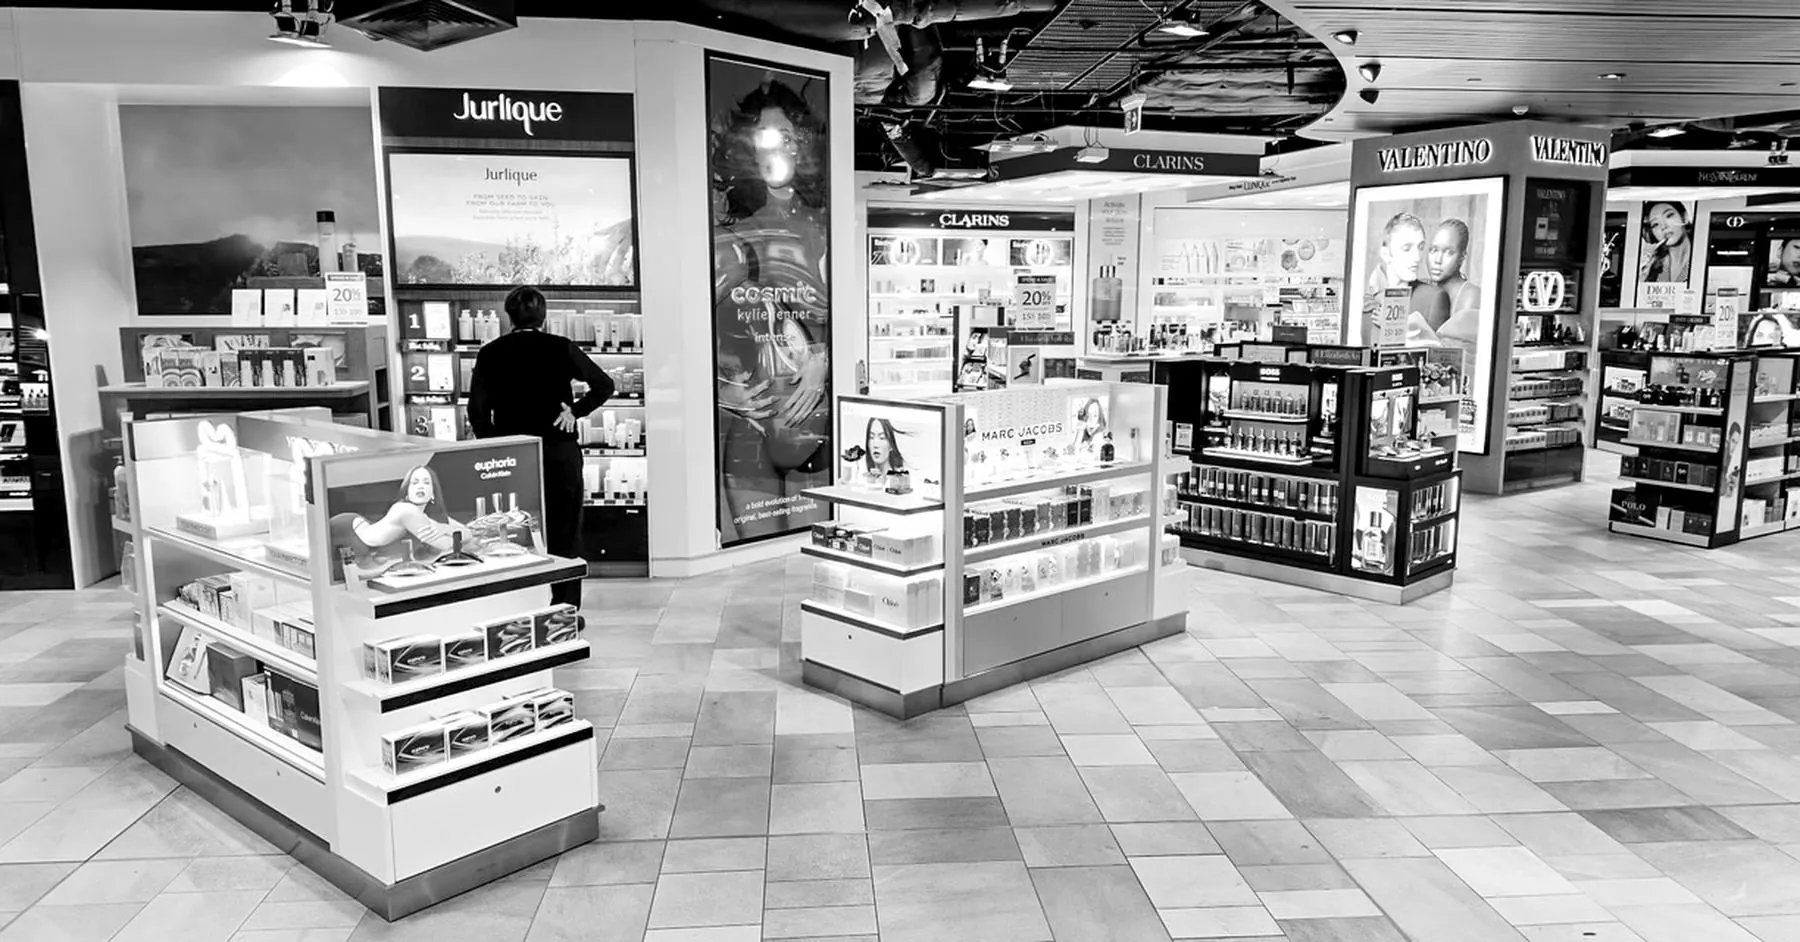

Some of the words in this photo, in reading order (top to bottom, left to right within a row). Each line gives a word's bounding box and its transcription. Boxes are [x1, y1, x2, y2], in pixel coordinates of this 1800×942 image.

[453, 92, 563, 136] Jurlique
[1377, 138, 1492, 172] VALENTINO
[1531, 135, 1608, 167] VALENTINO
[1133, 153, 1205, 171] CLARINS
[485, 167, 538, 187] Jurlique
[939, 213, 1010, 228] CLARINS
[730, 281, 817, 304] cosmic
[1647, 285, 1676, 295] DIOR
[408, 313, 421, 329] 1
[737, 308, 768, 324] kylie
[771, 309, 812, 322] enner
[410, 365, 426, 381] 2
[1260, 368, 1280, 376] BOSS
[415, 415, 429, 434] 3
[982, 428, 1015, 441] MARC
[1018, 423, 1063, 438] JACOBS
[474, 456, 517, 472] euphoria
[1621, 500, 1647, 511] POLO
